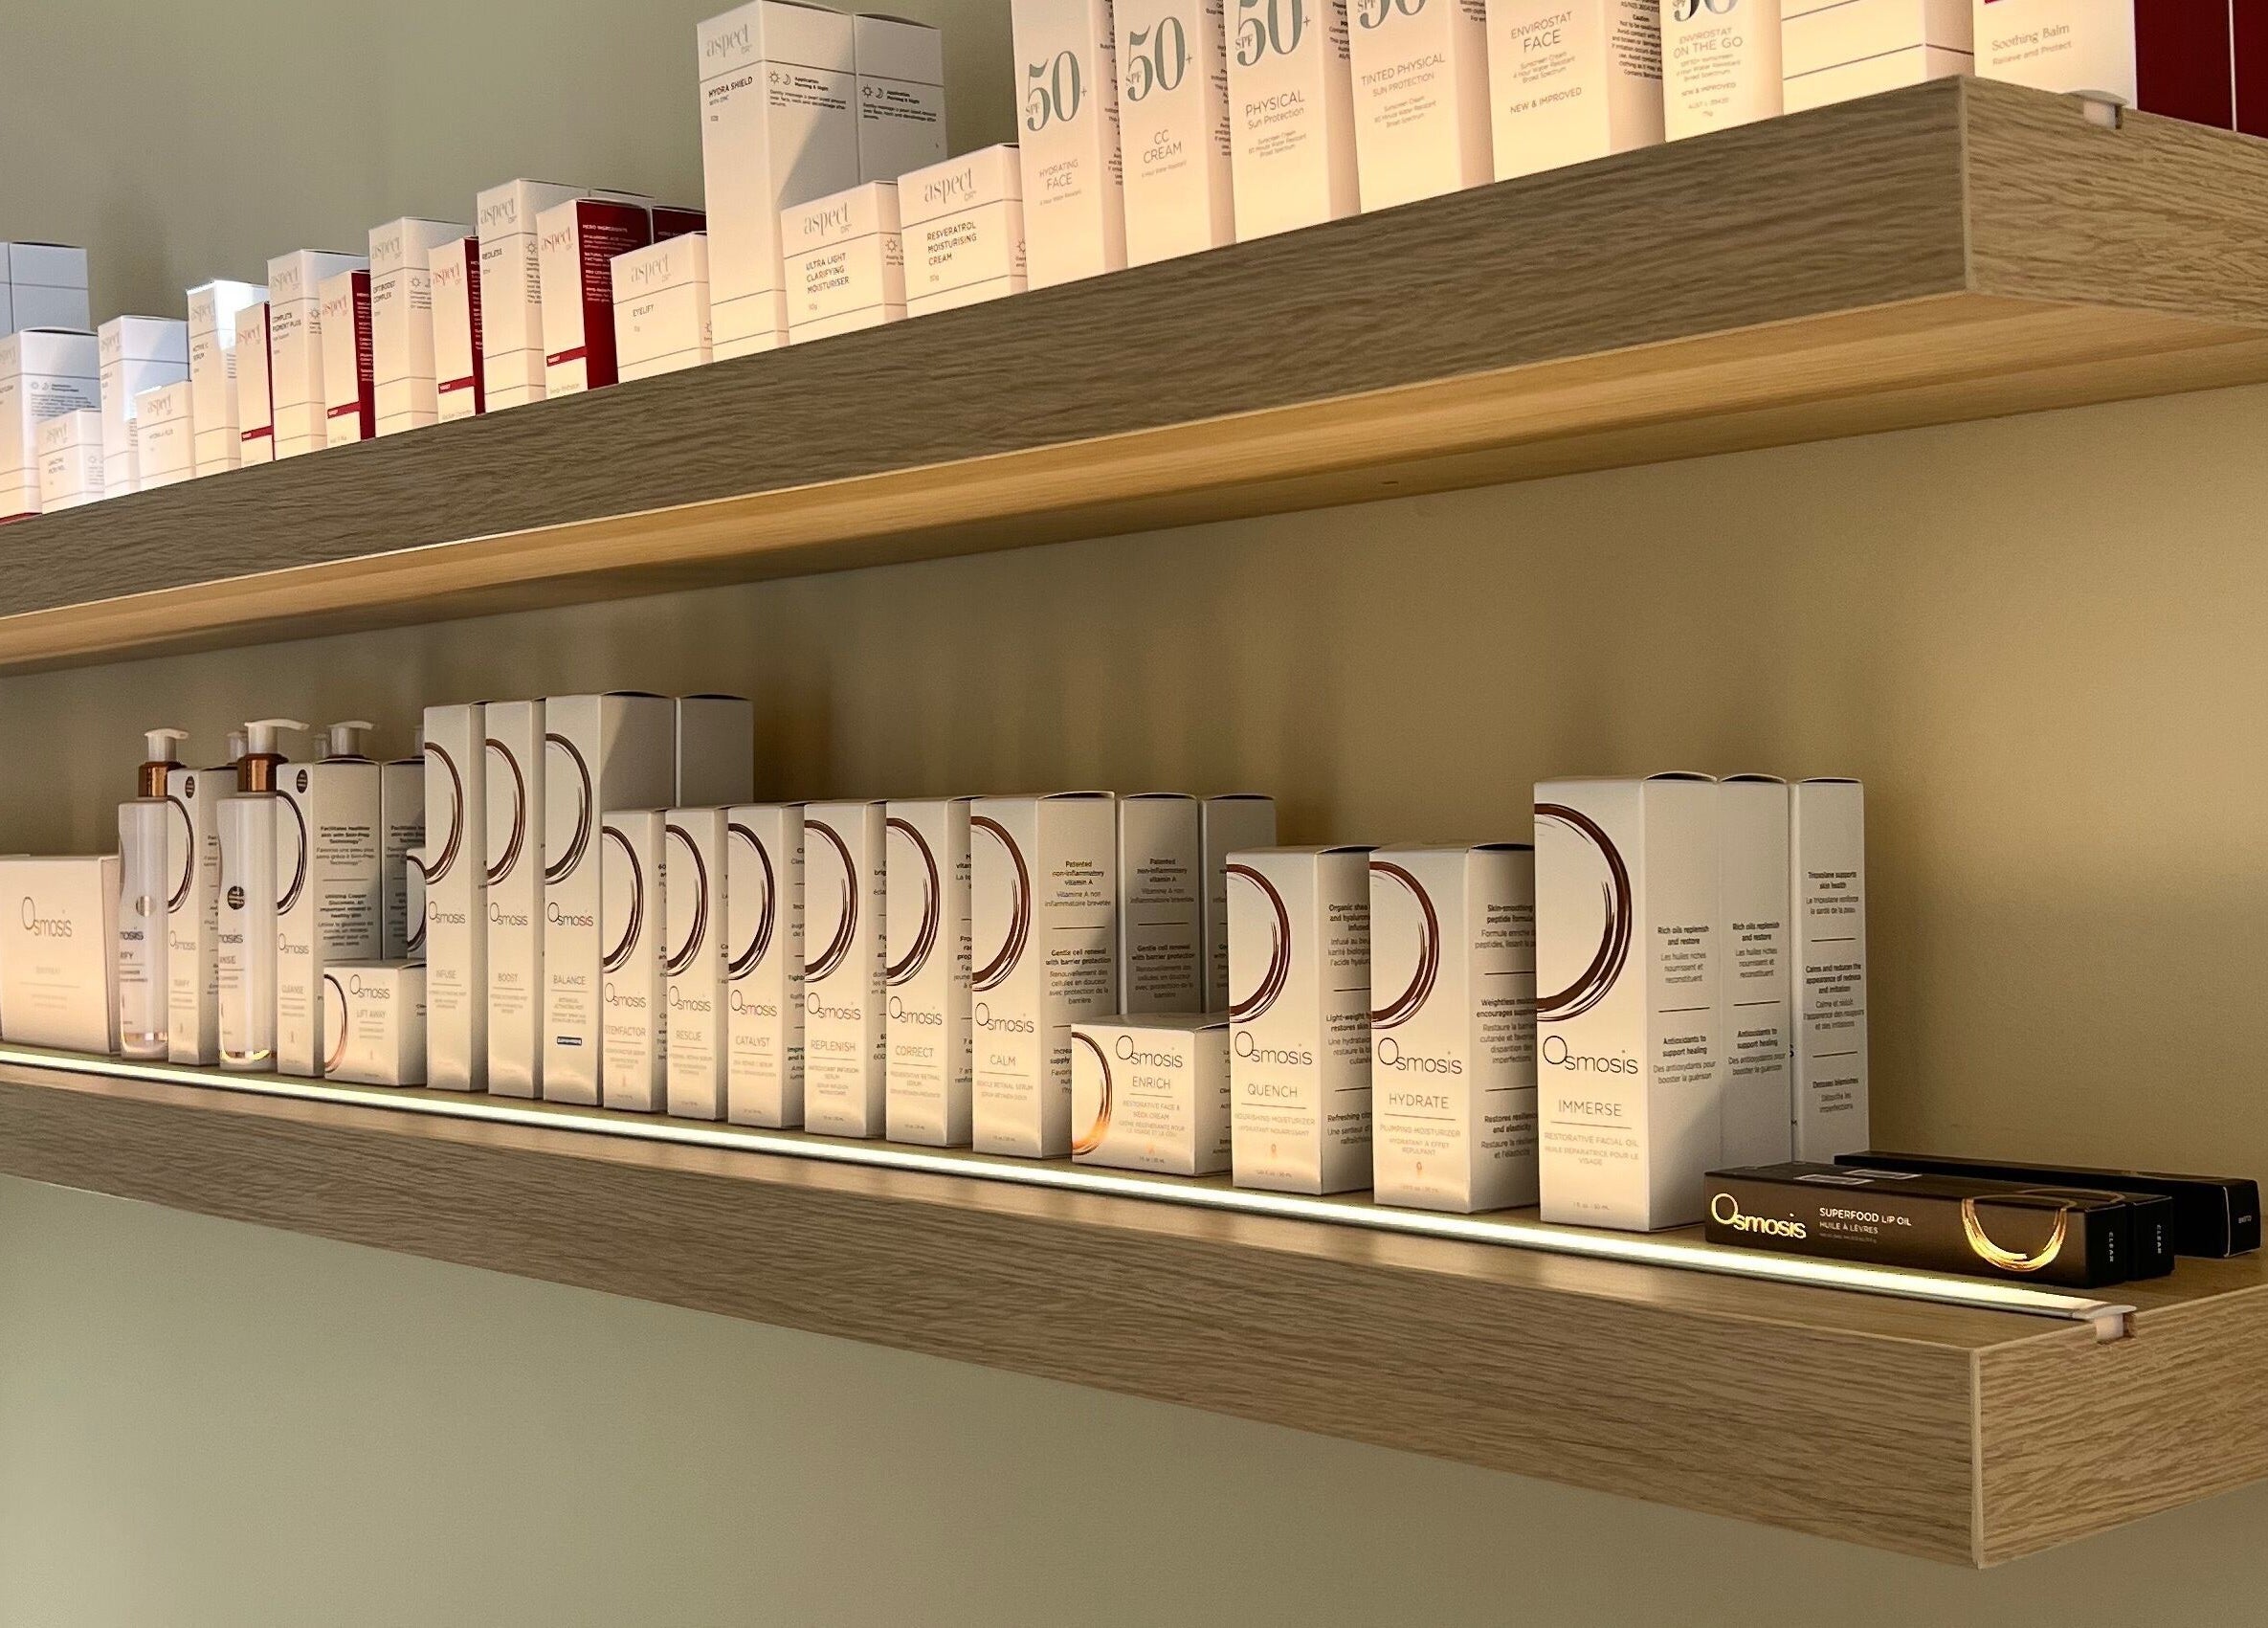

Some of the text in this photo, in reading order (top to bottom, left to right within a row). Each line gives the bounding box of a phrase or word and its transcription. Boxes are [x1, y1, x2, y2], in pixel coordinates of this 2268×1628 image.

[1510, 11, 1572, 40] ENVIROSTAT
[1679, 28, 1733, 45] ENVIROSTAT
[1991, 23, 2070, 53] Soothing Balm
[707, 23, 750, 58] aspect
[1234, 34, 1254, 51] SPF
[1523, 29, 1563, 54] FACE
[1673, 36, 1744, 58] ON THE GO
[1361, 54, 1446, 86] TINTED PHYSICAL
[708, 77, 754, 98] HYDRA SHIELD
[1372, 73, 1435, 98] SUN PROTECTION
[1245, 90, 1305, 117] PHYSICAL
[1510, 100, 1529, 114] NEW
[1539, 87, 1582, 107] IMPROVED
[1248, 107, 1305, 130] Sun Protection
[1153, 129, 1170, 145] CC
[1143, 142, 1183, 164] CREAM
[1039, 159, 1079, 178] HYDRATING
[924, 167, 974, 204] aspect
[1046, 172, 1073, 191] FACE
[480, 197, 515, 228] aspect
[804, 202, 849, 236] aspect
[541, 226, 573, 252] aspect
[926, 221, 976, 241] RESVERATROL
[927, 234, 977, 254] MOISTURISING
[632, 254, 670, 283] aspect
[806, 252, 847, 272] ULTRA LIGHT
[928, 253, 953, 266] CREAM
[433, 262, 461, 287] aspect
[807, 265, 845, 283] CLARIFYING
[807, 277, 850, 294] MOISTURISER
[22, 896, 73, 938] Osmosis
[429, 901, 466, 926] Osmosis
[489, 902, 528, 926] Osmosis
[546, 902, 594, 927] Osmosis
[349, 974, 391, 999] Osmosis
[552, 975, 587, 986] BALANCE
[604, 982, 647, 1008] Osmosis
[668, 985, 712, 1013] Osmosis
[730, 989, 779, 1017] Osmosis
[807, 992, 861, 1021] Osmosis
[889, 995, 943, 1026] Osmosis
[975, 1002, 1034, 1034] Osmosis
[735, 1036, 771, 1048] CATALYST
[811, 1039, 856, 1053] REPLENISH
[895, 1045, 935, 1059] CORRECT
[1115, 1035, 1183, 1068] Osmosis
[1234, 1031, 1313, 1065] Osmosis
[989, 1054, 1016, 1067] CALM
[1378, 1037, 1462, 1075] Osmosis
[1543, 1035, 1639, 1075] Osmosis
[1132, 1077, 1171, 1090] ENRICH
[1247, 1082, 1298, 1099] QUENCH
[1388, 1093, 1450, 1110] HYDRATE
[1558, 1099, 1623, 1118] IMMERSE
[1544, 1131, 1639, 1149] RESTORATIVE FACIAL OIL
[1710, 1193, 1808, 1239] Osmosis
[1819, 1207, 1913, 1227] SUPERFOOD LIP OIL
[1819, 1221, 1841, 1231] HUILE
[1849, 1223, 1879, 1235] LÈVRES
